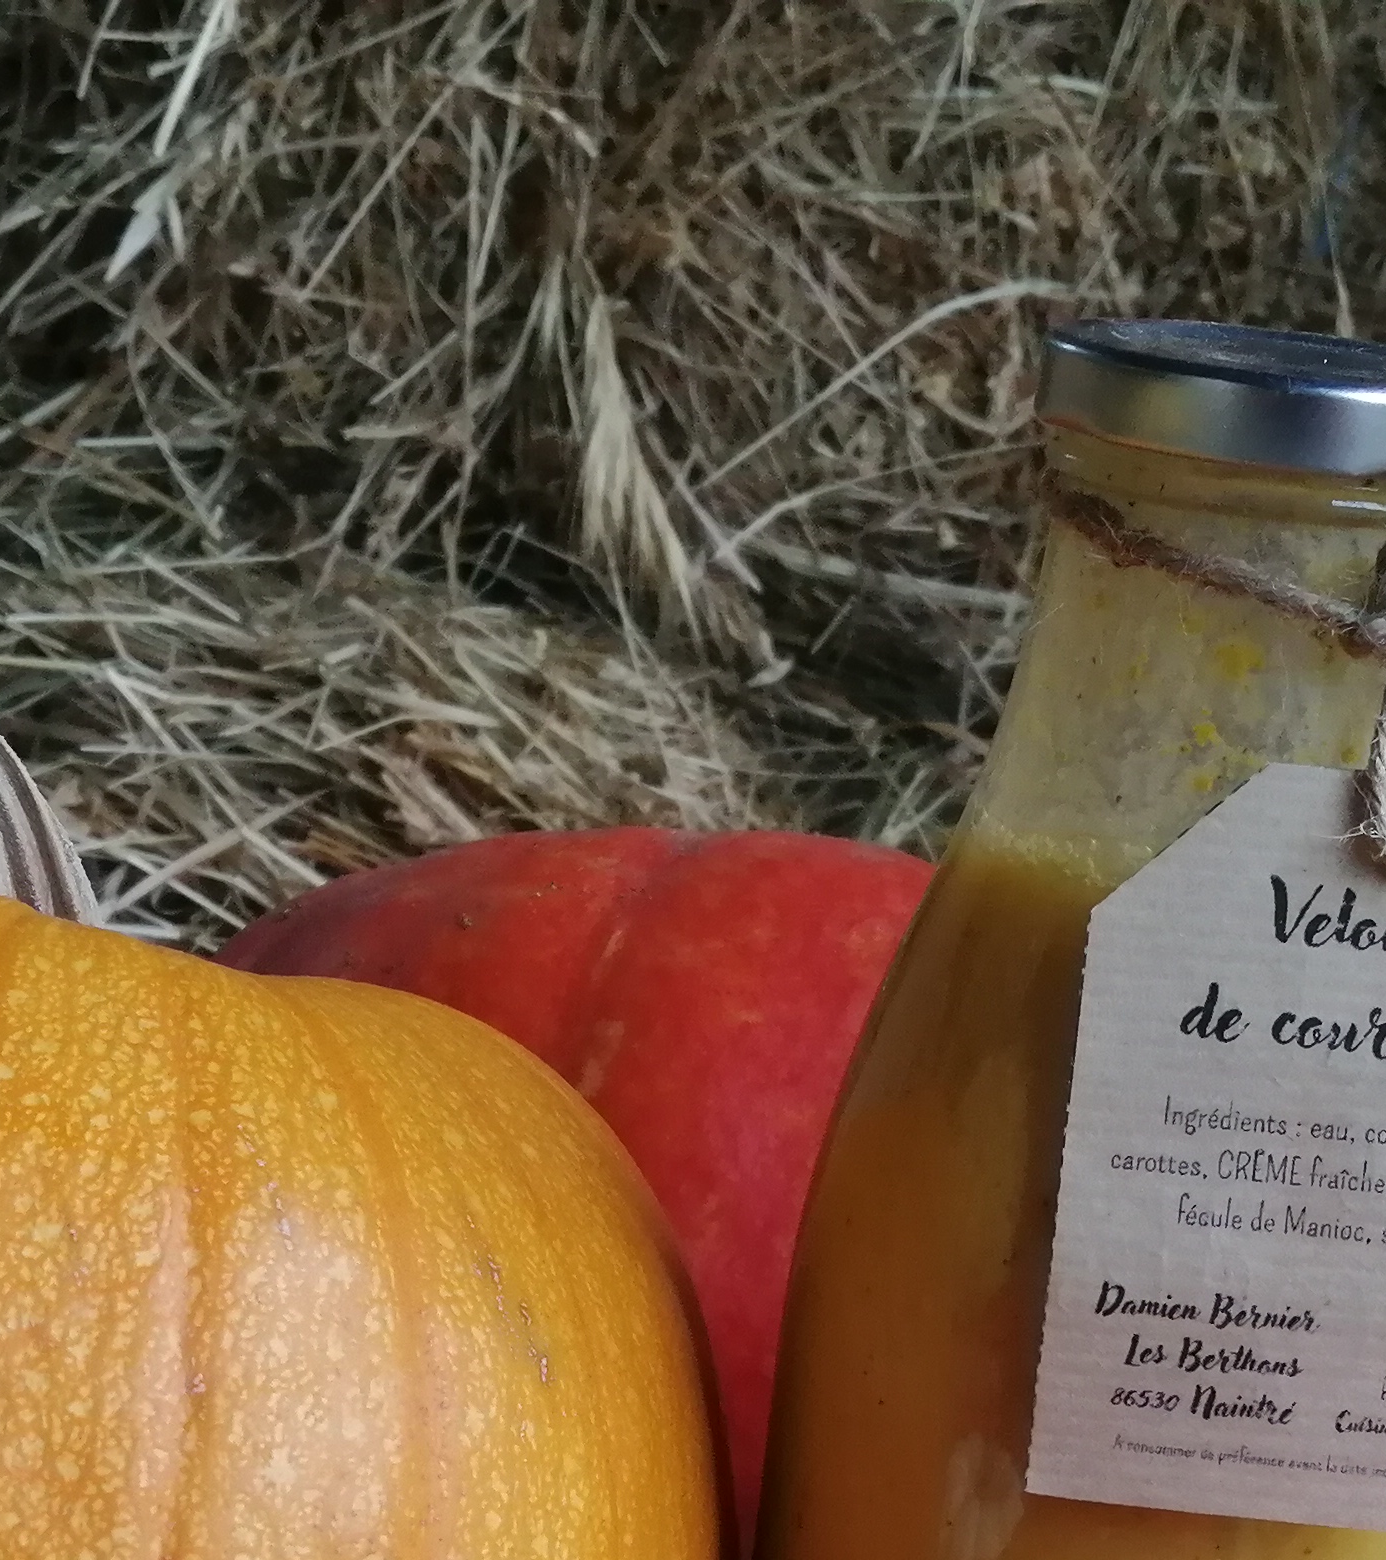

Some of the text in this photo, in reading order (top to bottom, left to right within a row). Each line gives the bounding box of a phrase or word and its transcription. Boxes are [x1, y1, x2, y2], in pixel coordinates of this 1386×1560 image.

[1178, 982, 1253, 1044] de
[1164, 1094, 1288, 1136] Ingrédients
[1310, 1121, 1356, 1144] eau,
[1177, 1192, 1243, 1230] fécule
[1250, 1200, 1276, 1234] de
[1094, 1279, 1321, 1334] Damien Bernier
[1124, 1333, 1168, 1367] Les
[1110, 1384, 1298, 1425] 86530 Naintré
